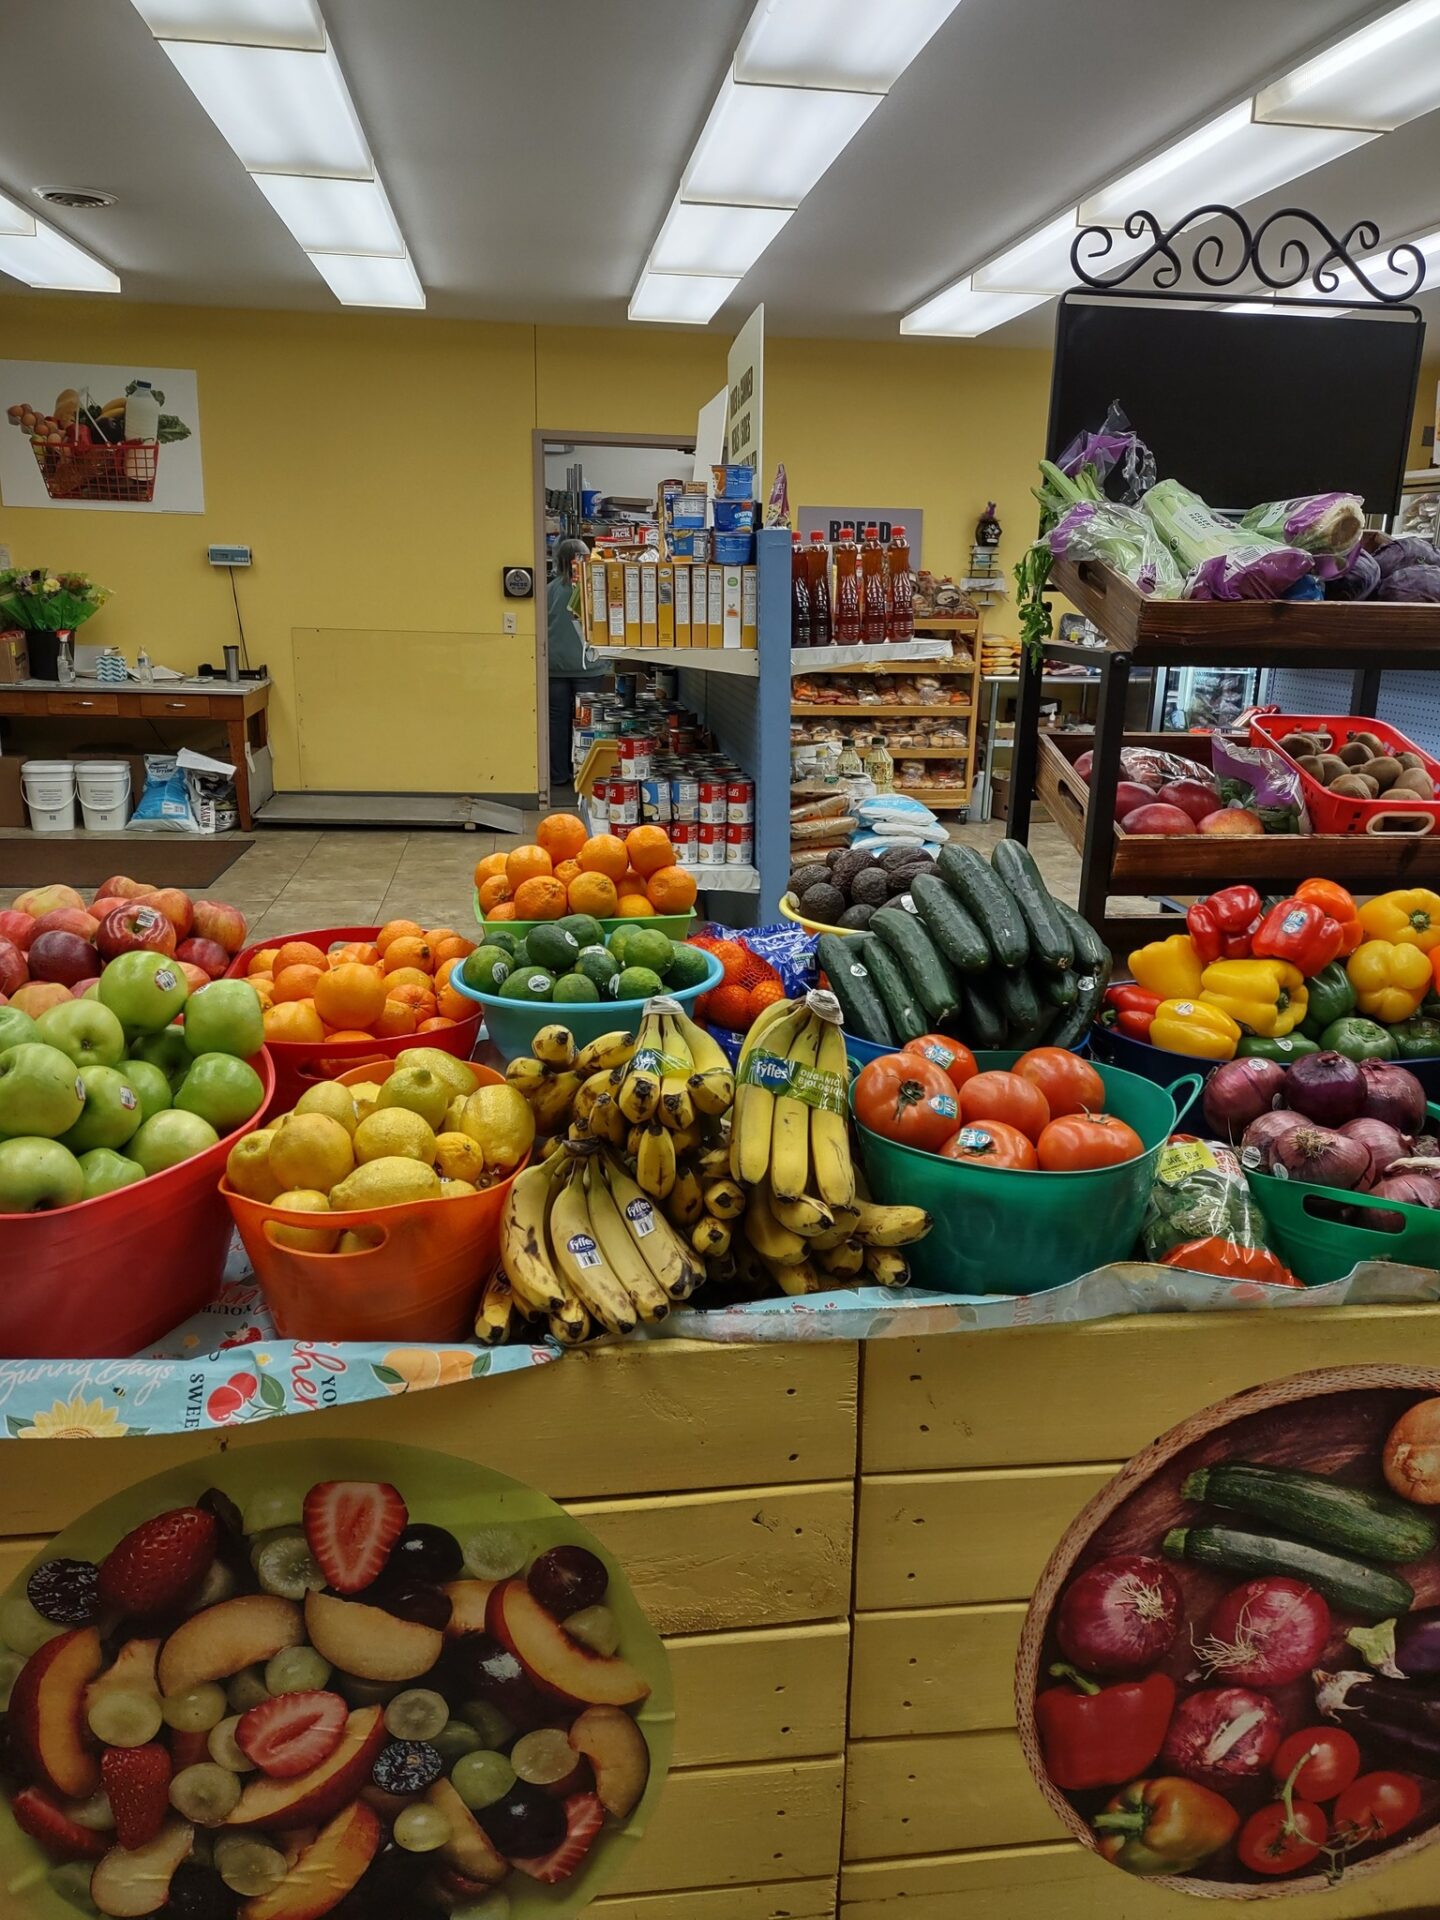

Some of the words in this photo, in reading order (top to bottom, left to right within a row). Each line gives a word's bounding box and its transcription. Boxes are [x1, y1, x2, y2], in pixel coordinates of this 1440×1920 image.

[201, 1303, 252, 1316] YOU'R
[95, 1360, 175, 1406] Days
[185, 1374, 205, 1430] SWEE
